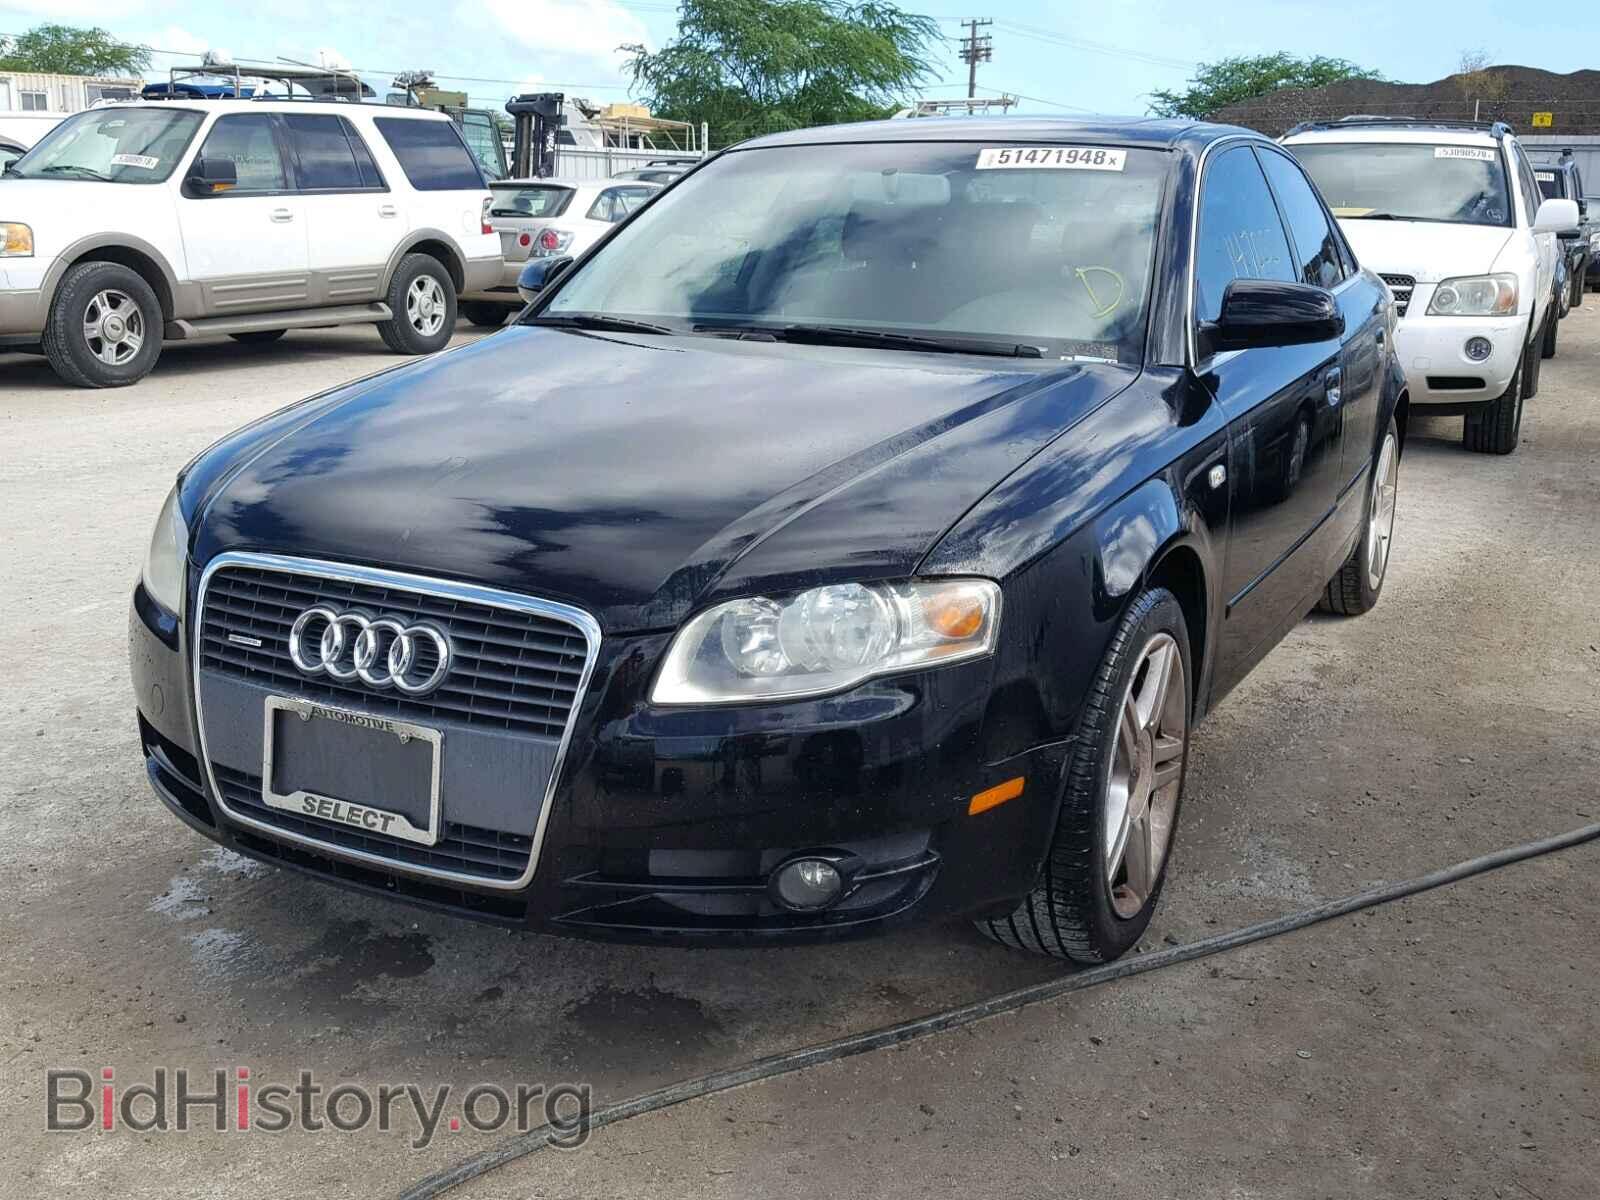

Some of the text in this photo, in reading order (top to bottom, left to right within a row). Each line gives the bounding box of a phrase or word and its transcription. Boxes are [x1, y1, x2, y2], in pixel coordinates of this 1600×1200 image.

[1075, 266, 1124, 320] D
[311, 706, 394, 732] AUTOMOTIVE
[302, 795, 395, 832] SELECT
